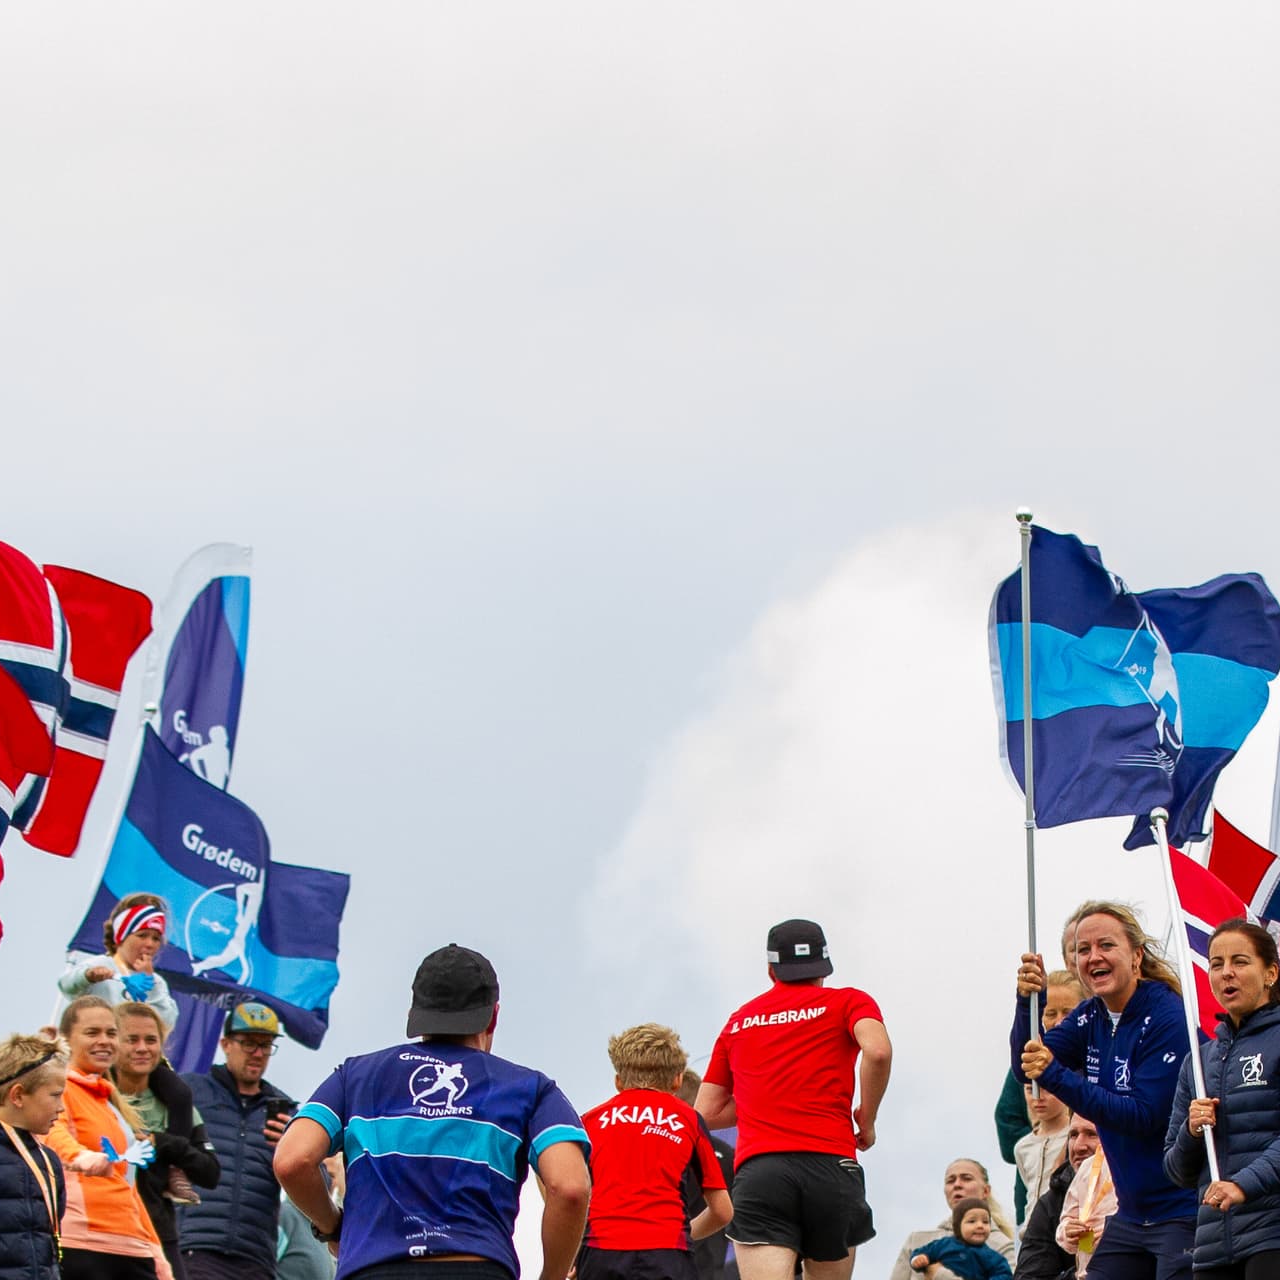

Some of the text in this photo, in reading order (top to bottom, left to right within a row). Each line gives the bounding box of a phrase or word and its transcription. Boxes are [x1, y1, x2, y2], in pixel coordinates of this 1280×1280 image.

[181, 823, 258, 882] Grødem
[741, 1006, 827, 1029] DALEBRAND
[419, 1106, 473, 1117] RUNNERS
[598, 1105, 685, 1132] SKJALG
[640, 1124, 683, 1145] friidrett
